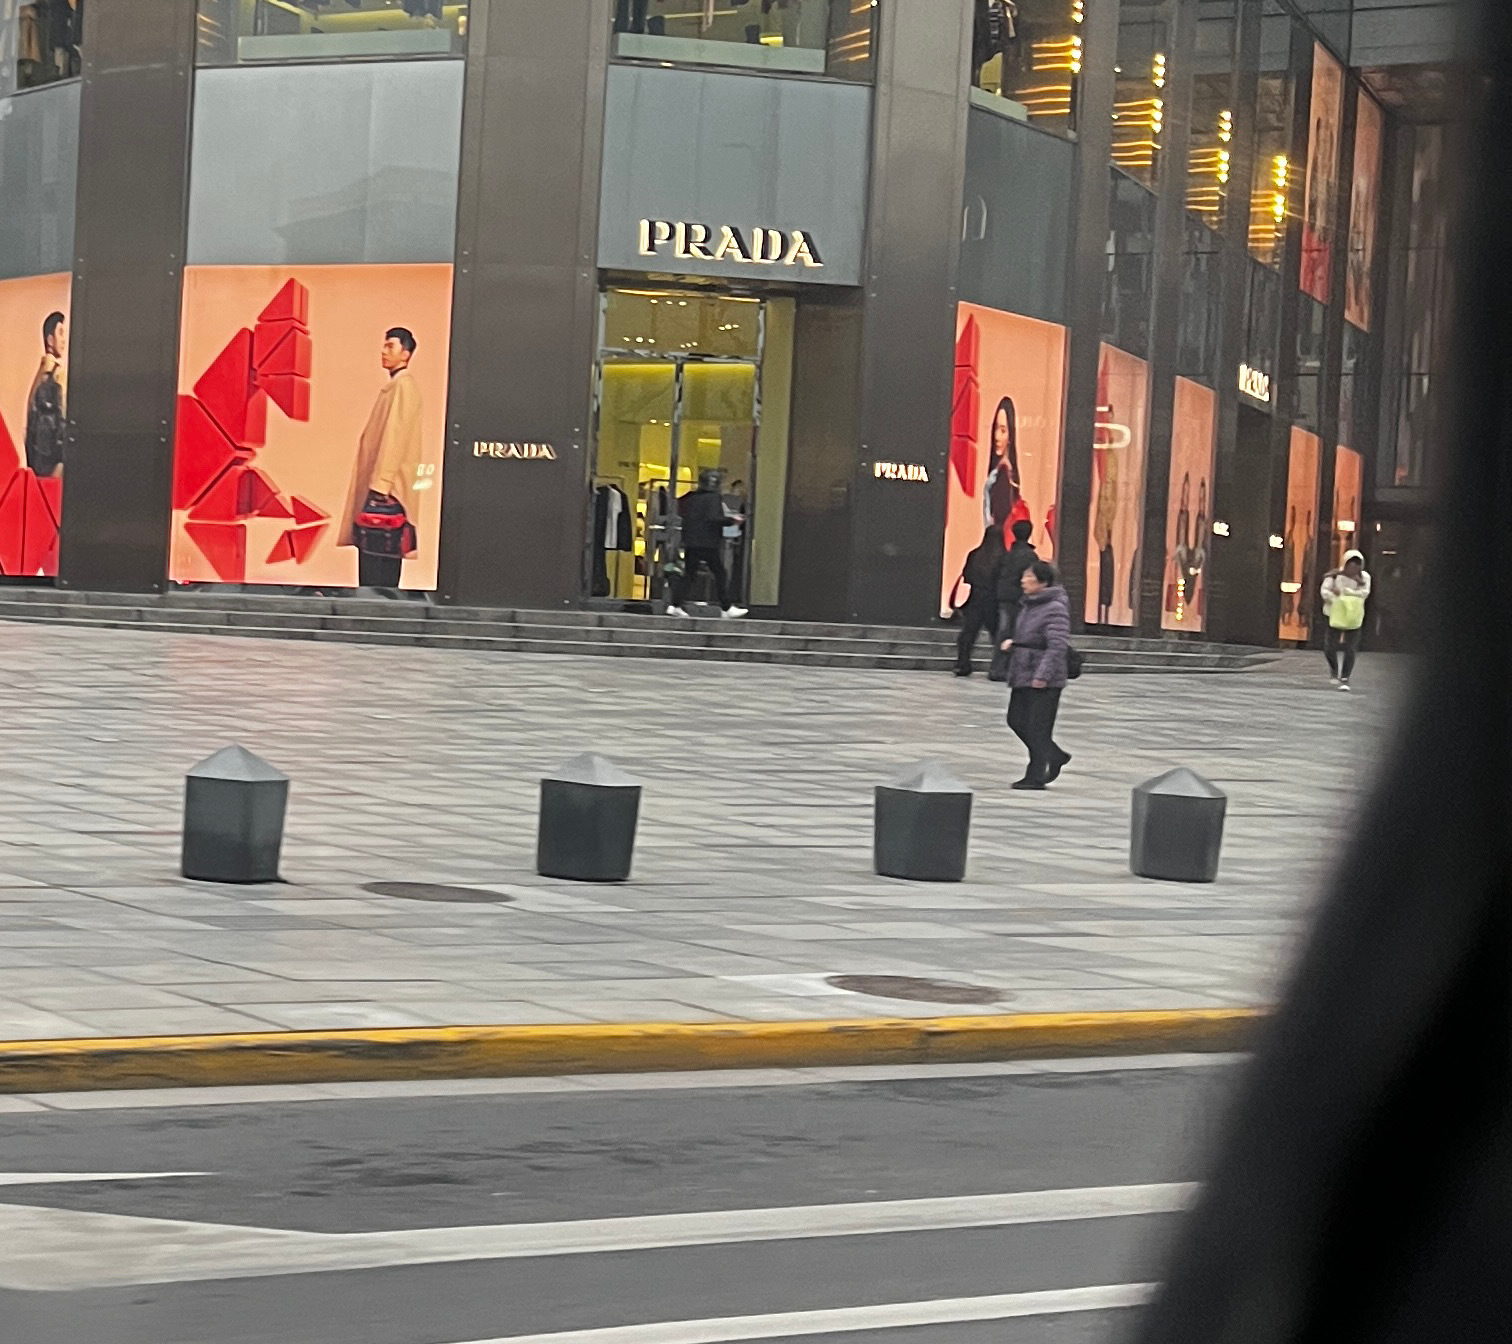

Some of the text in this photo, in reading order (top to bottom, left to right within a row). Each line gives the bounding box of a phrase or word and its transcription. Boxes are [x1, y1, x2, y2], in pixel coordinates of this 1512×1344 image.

[639, 218, 824, 268] PRADA
[473, 441, 557, 460] PRADA
[874, 462, 929, 483] PRADA
